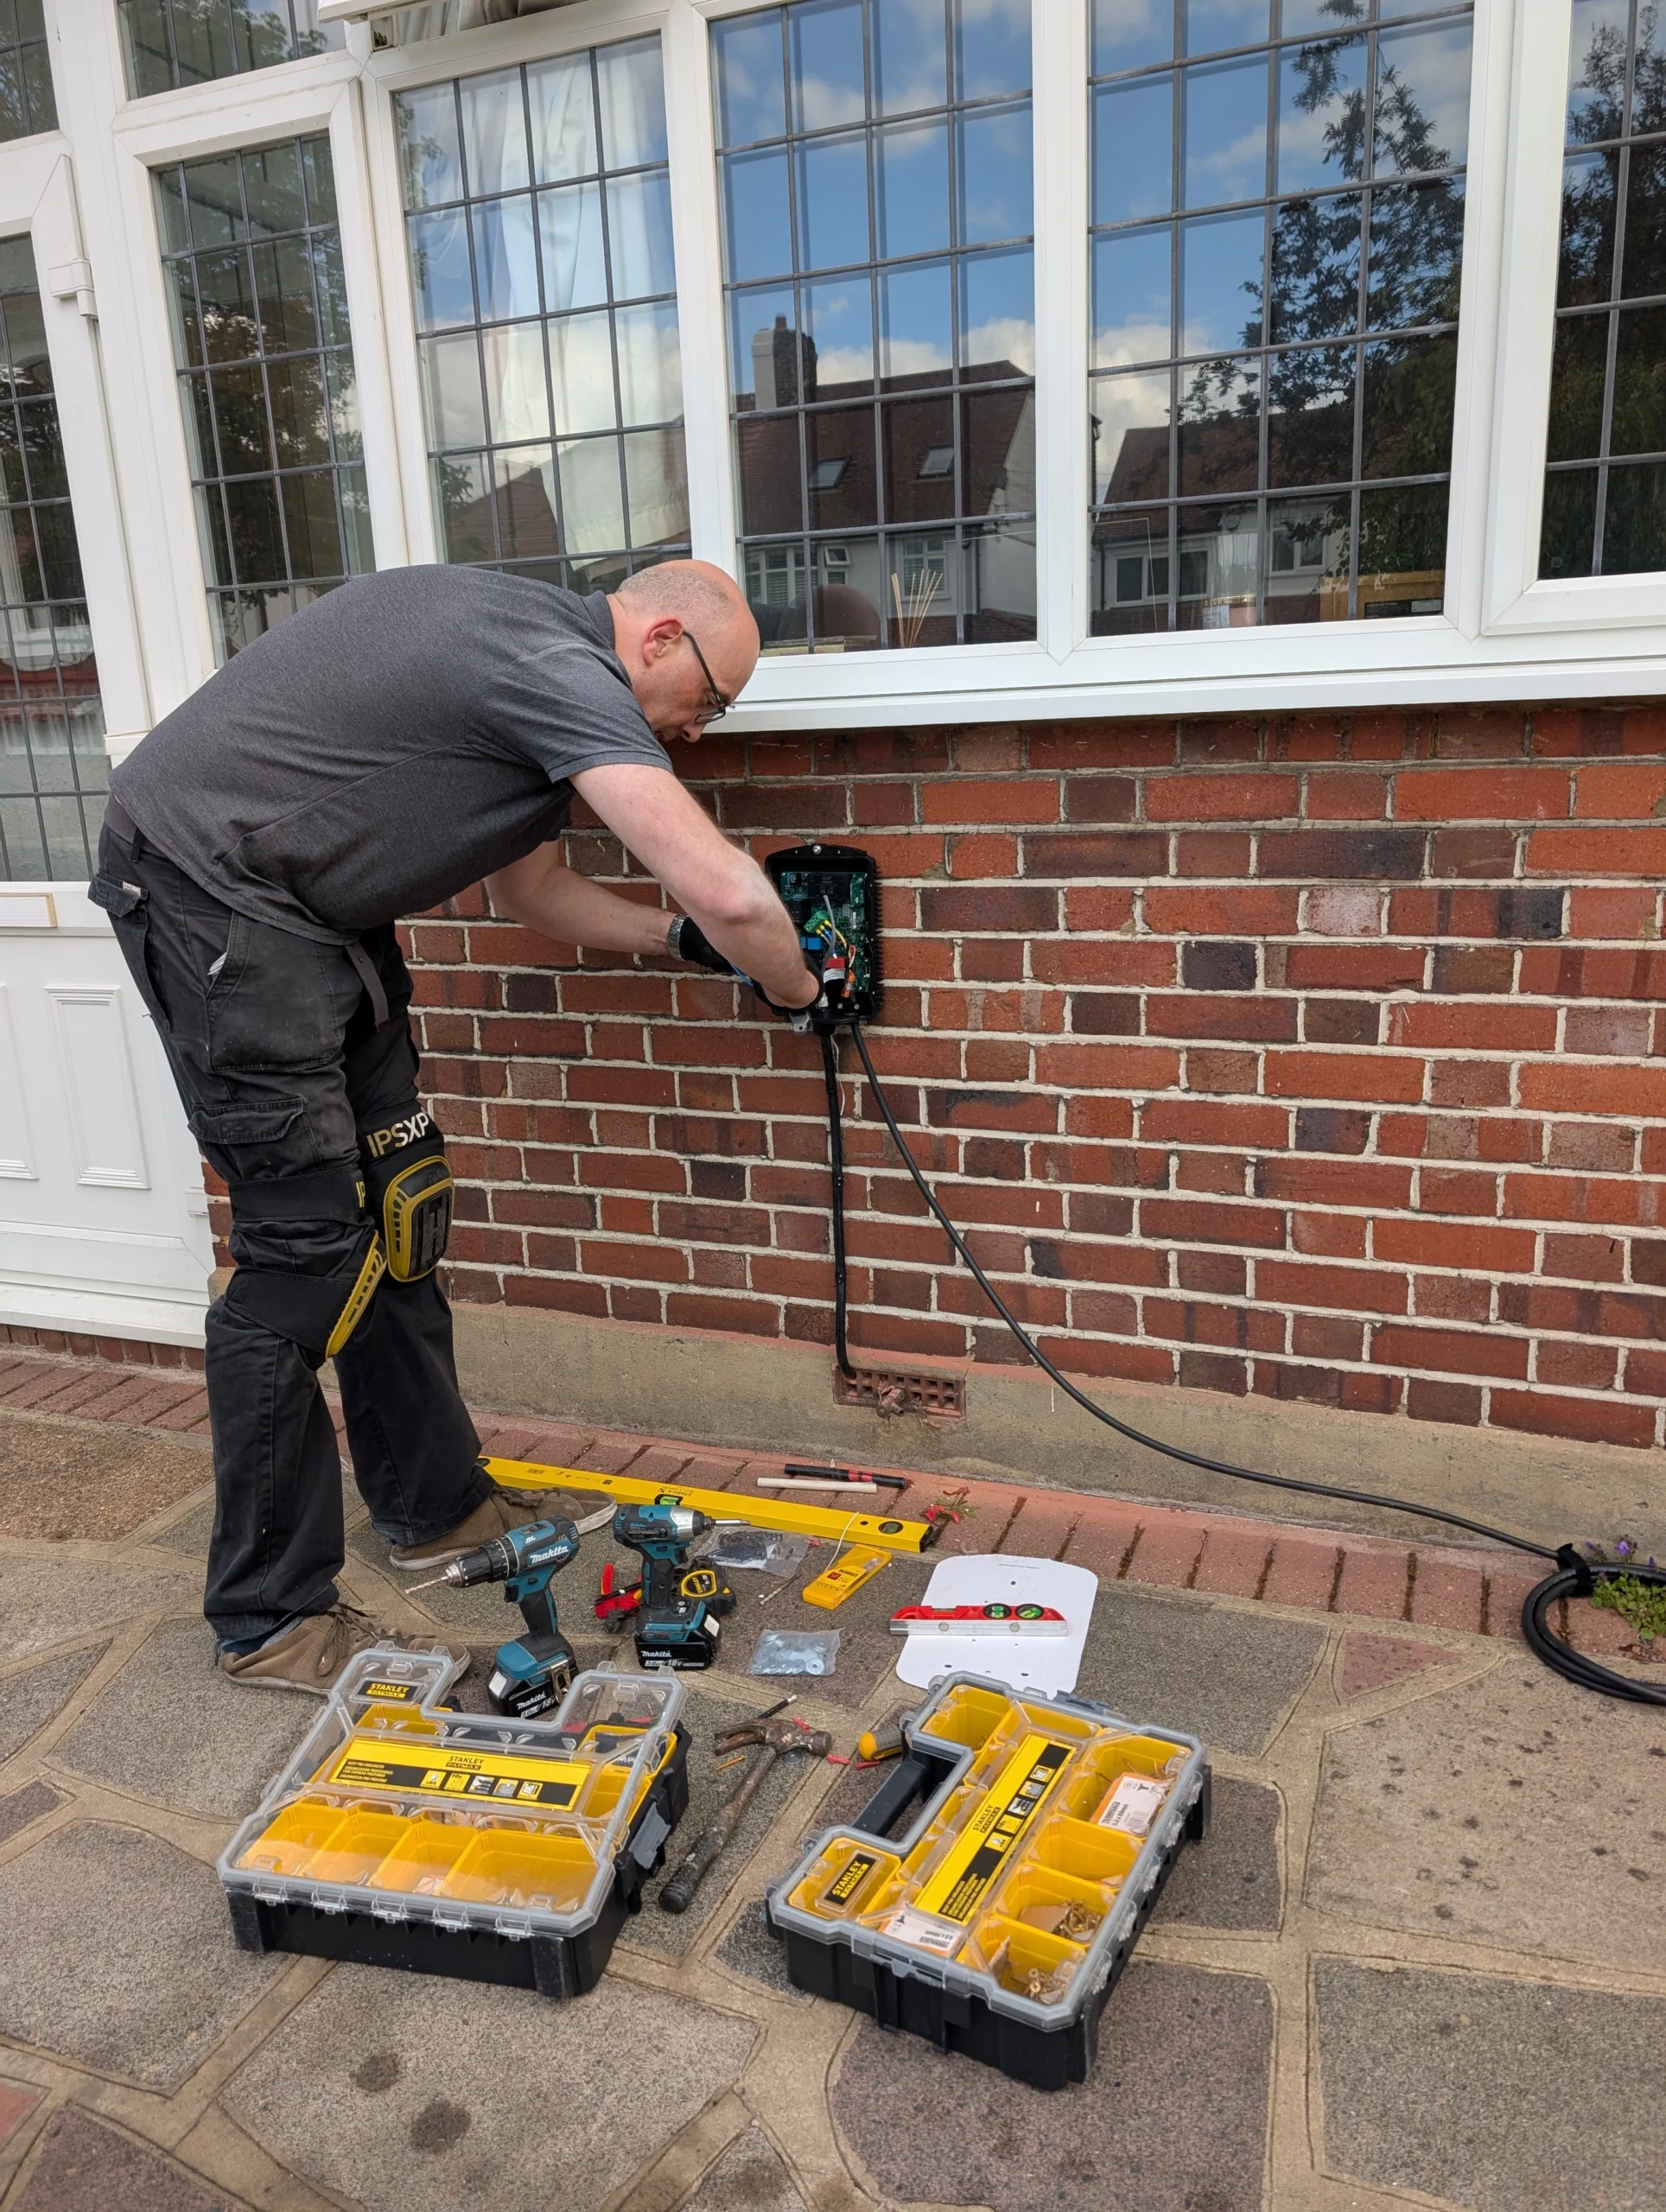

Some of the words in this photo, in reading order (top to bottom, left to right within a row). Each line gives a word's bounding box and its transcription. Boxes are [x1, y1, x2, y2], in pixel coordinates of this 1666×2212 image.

[366, 1107, 429, 1158] IPSXP
[530, 1545, 569, 1565] makita
[370, 1682, 410, 1694] STANLEY
[516, 1690, 547, 1710] makita
[446, 1762, 481, 1770] FATMAX
[448, 1755, 485, 1765] STANLEY
[972, 1804, 994, 1832] STANLEY
[980, 1807, 1001, 1833] FATMAX
[831, 1860, 862, 1896] STANLEY
